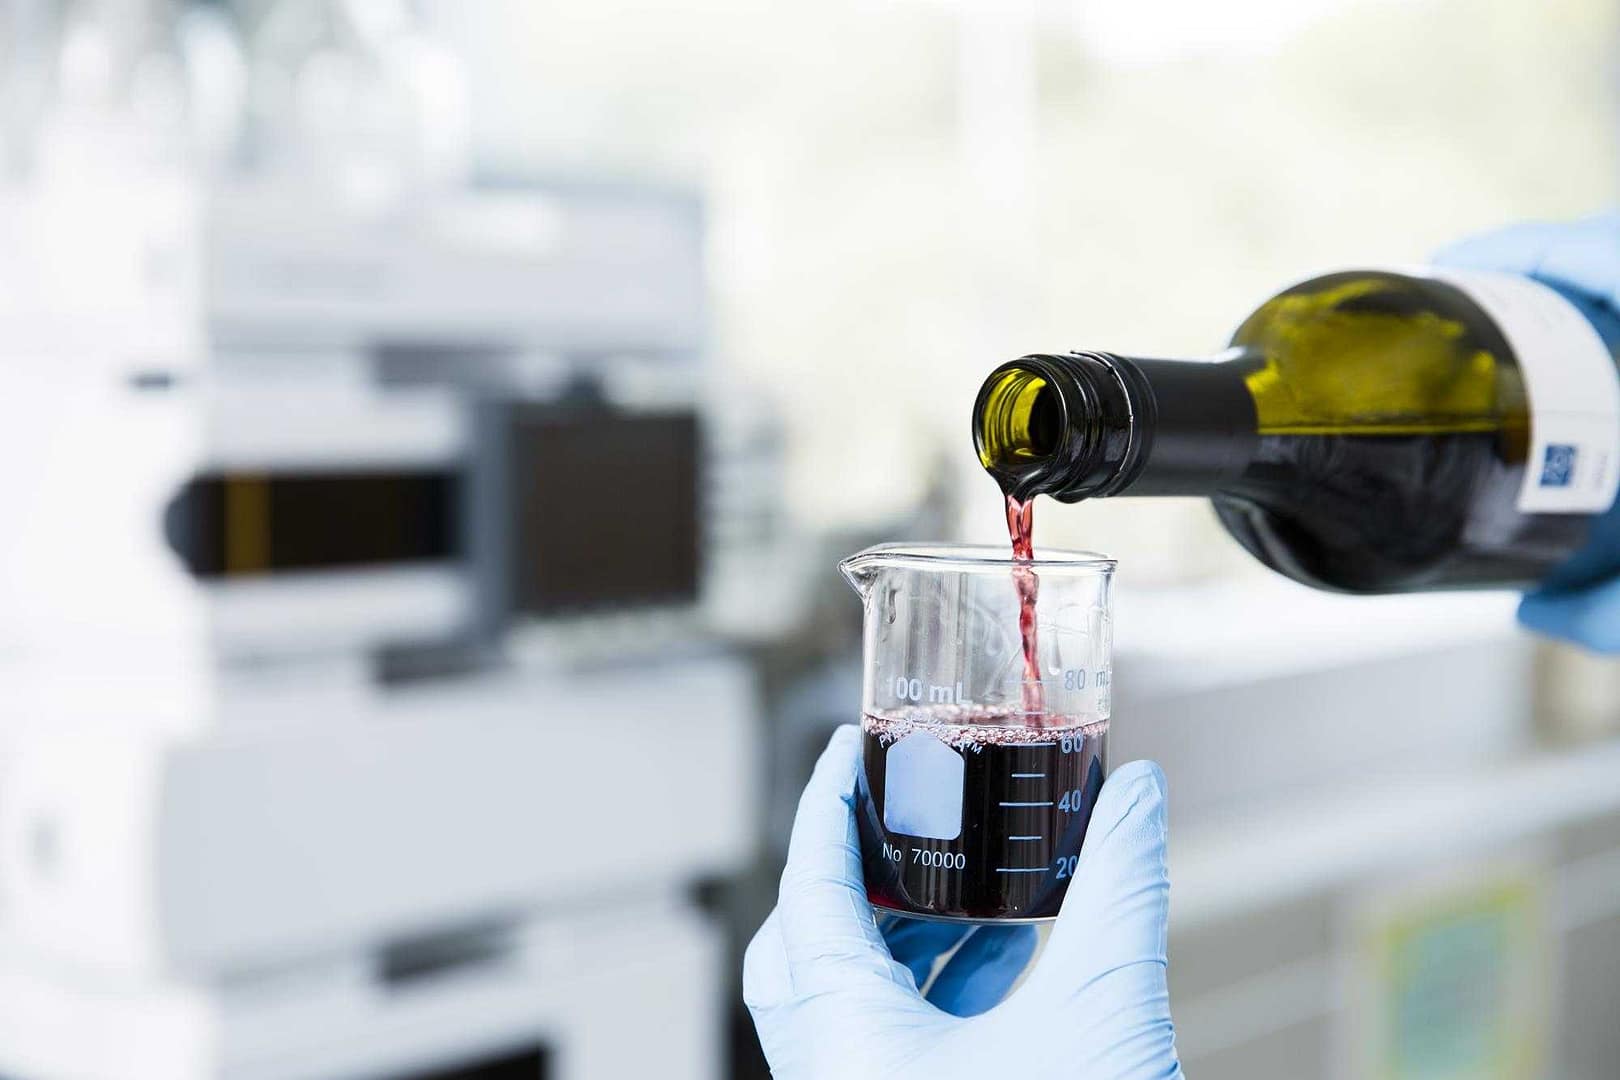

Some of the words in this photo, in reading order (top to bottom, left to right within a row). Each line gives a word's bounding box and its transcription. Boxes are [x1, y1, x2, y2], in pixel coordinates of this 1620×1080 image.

[1064, 669, 1085, 690] 80
[929, 680, 973, 705] mL
[1061, 729, 1083, 754] 60
[1057, 790, 1081, 813] 40
[883, 843, 902, 862] No
[911, 848, 966, 870] 70000
[1055, 855, 1078, 880] 20
